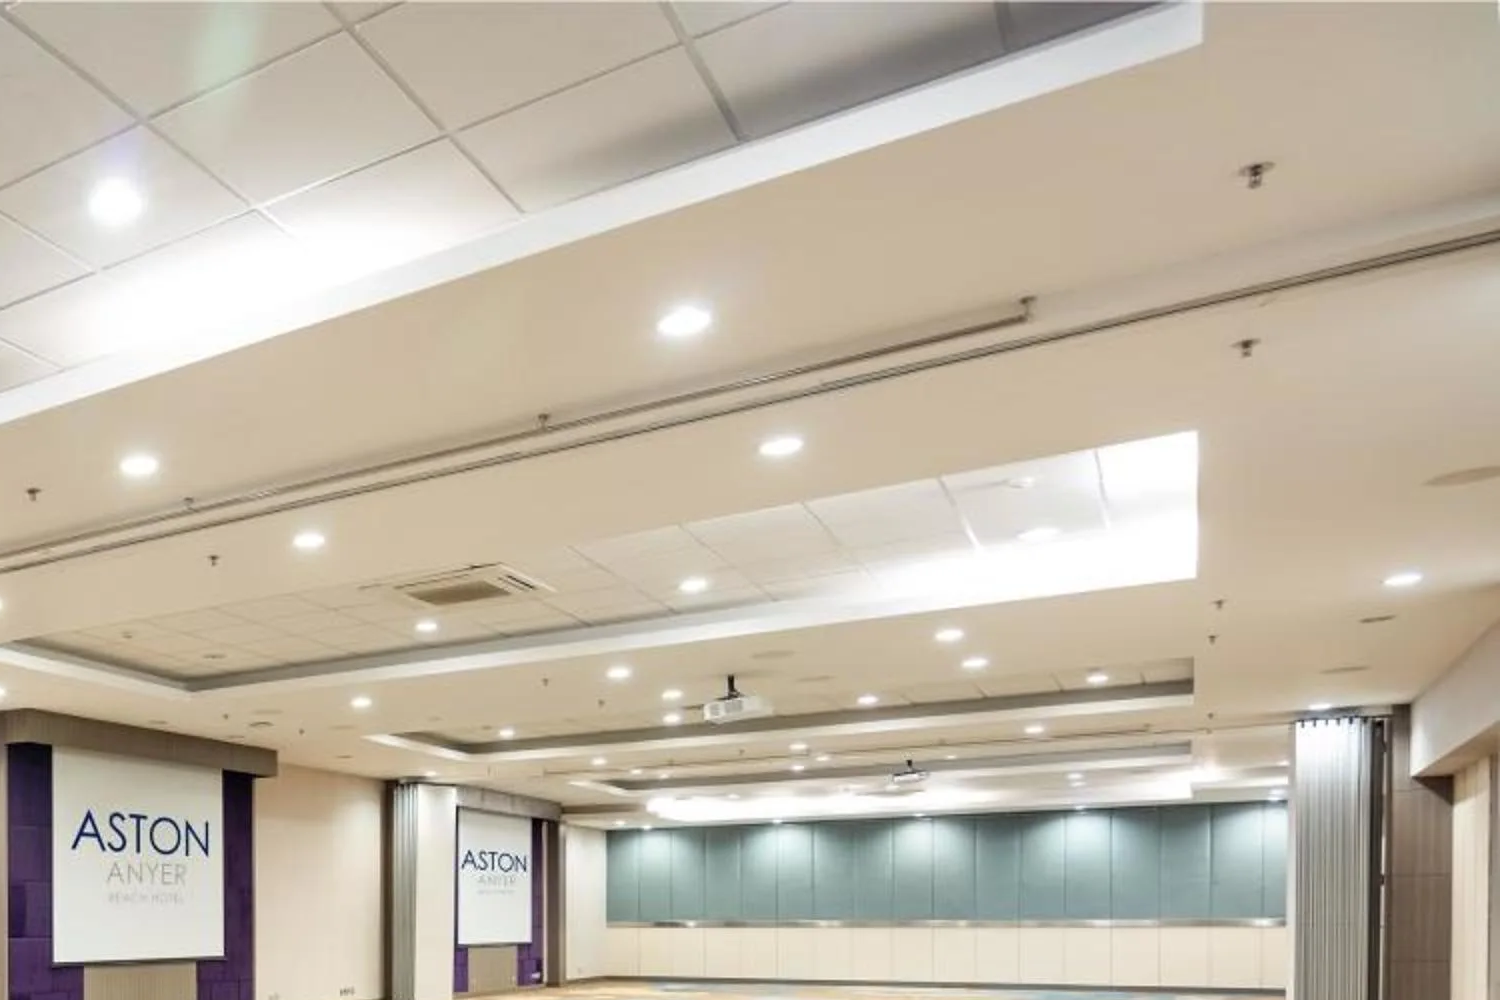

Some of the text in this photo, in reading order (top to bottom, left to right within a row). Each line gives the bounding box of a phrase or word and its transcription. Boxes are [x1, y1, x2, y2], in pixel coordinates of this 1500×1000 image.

[71, 809, 209, 857] ASTON
[461, 849, 527, 872] ASTON
[106, 862, 187, 885] ANYER
